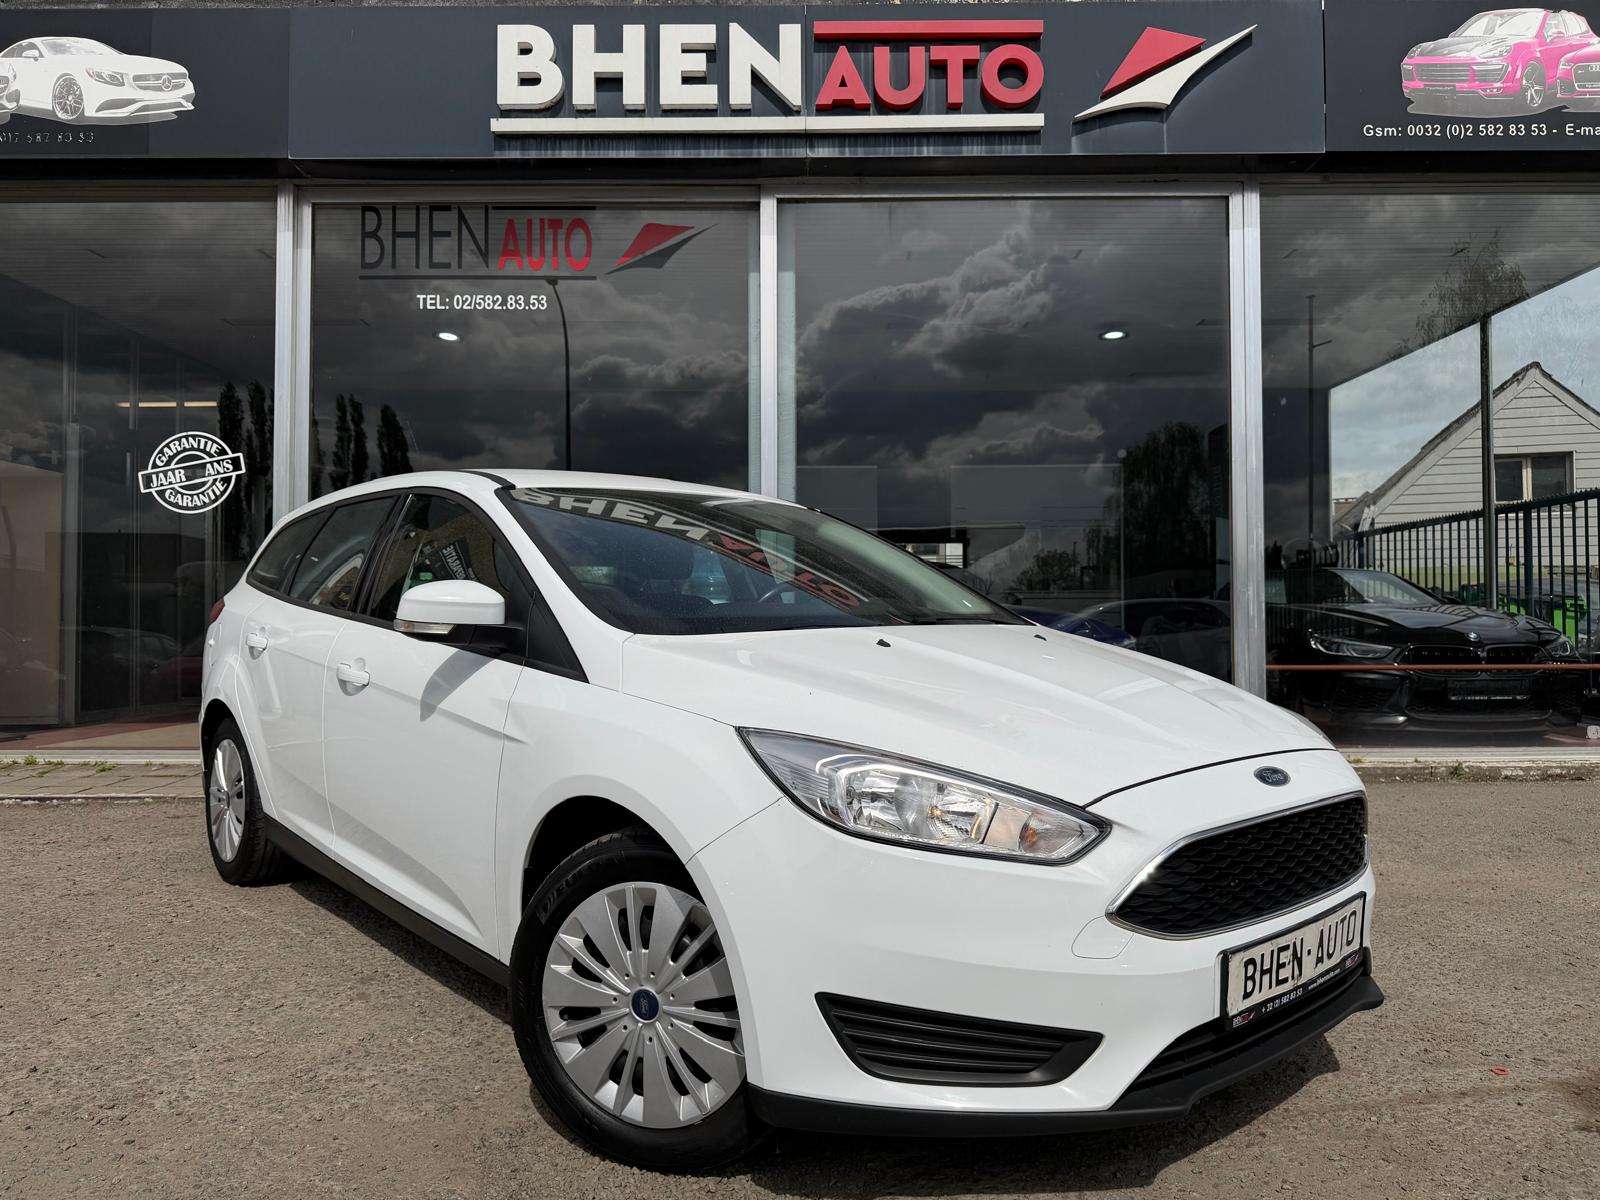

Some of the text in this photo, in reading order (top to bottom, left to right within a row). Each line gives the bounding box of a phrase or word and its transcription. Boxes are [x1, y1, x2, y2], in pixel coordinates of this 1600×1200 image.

[496, 23, 1045, 112] BHEN AUTO
[1363, 124, 1402, 137] Gsm:
[1407, 124, 1441, 136] 0032
[1446, 124, 1474, 139] (0)2
[1478, 124, 1504, 136] 582
[1509, 124, 1526, 136] 83
[1531, 124, 1547, 136] 53
[361, 205, 592, 271] BHEN AUTO
[417, 294, 548, 311] TEL: 02/582.83.53
[155, 437, 222, 467] GARANTIE
[150, 459, 234, 488] JAAR ANS
[164, 479, 228, 507] GARANTIE
